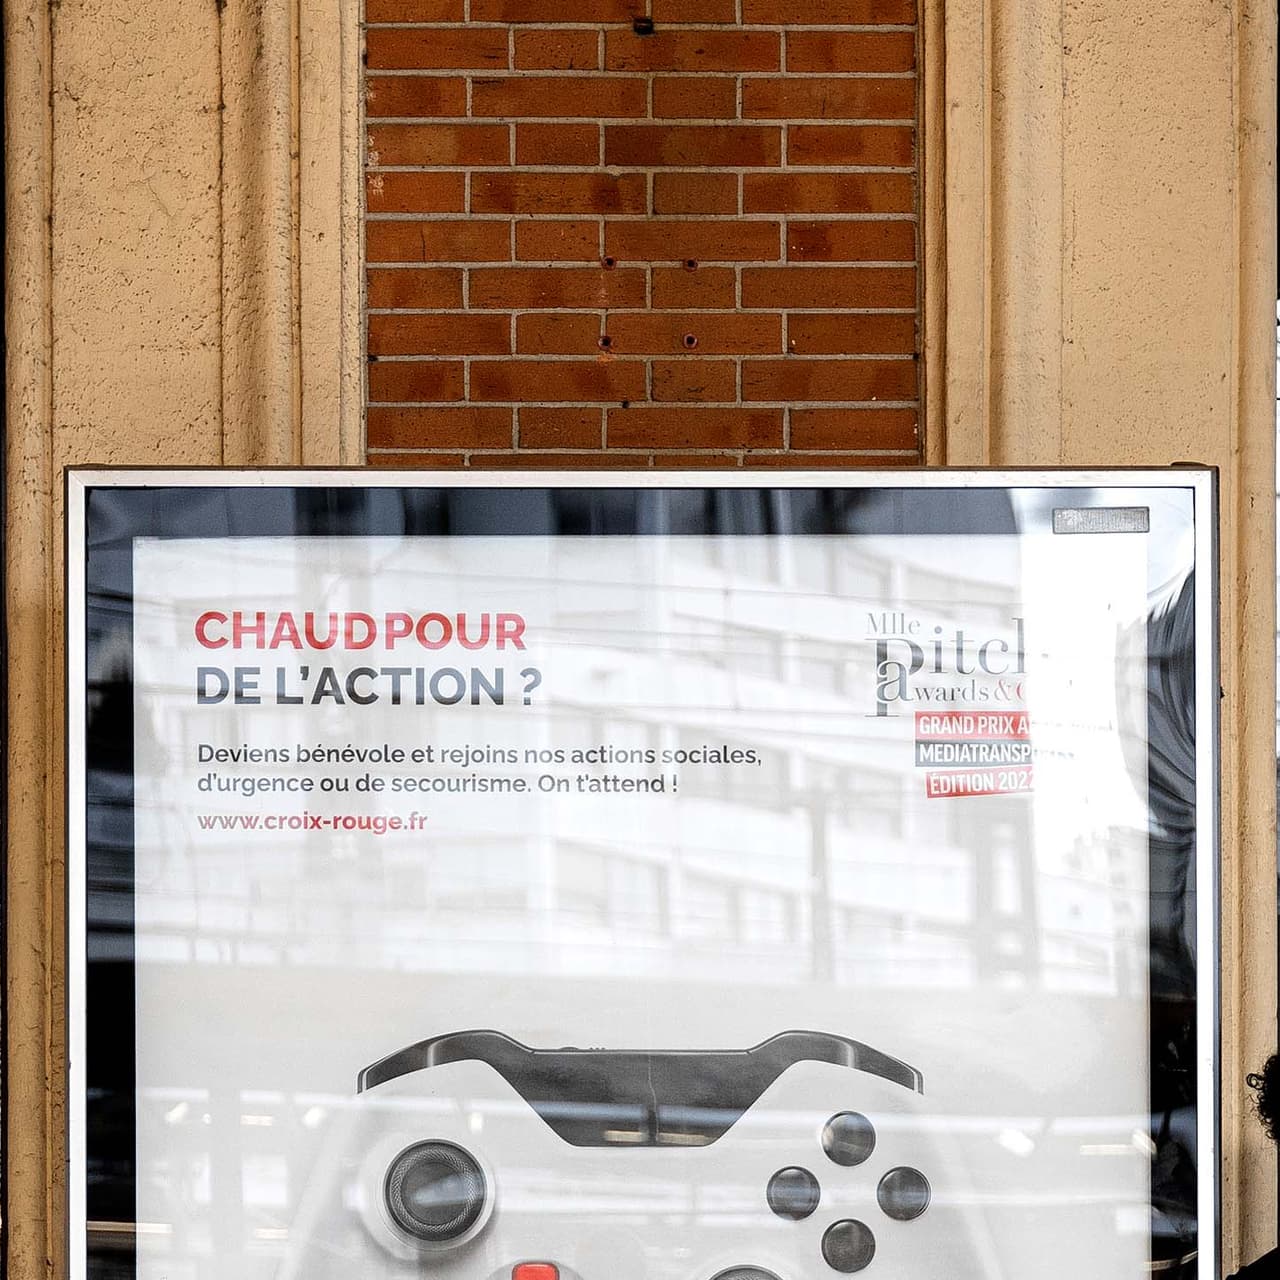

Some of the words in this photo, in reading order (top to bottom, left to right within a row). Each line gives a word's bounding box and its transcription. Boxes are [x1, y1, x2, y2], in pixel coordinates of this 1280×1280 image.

[194, 610, 377, 650] CHAUD
[384, 611, 528, 651] POUR
[196, 666, 262, 705] DE
[276, 665, 505, 706] L’ACTION
[519, 666, 543, 706] ?
[919, 715, 975, 735] GRAND
[977, 715, 1015, 735] PRIX
[198, 743, 290, 764] Deviens
[296, 743, 405, 764] bénévole
[410, 746, 435, 764] et
[440, 745, 519, 768] rejoins
[524, 749, 565, 764] nos
[571, 745, 656, 764] actions
[661, 745, 762, 767] sociales,
[197, 773, 314, 797] d’urgence
[320, 778, 349, 792] ou
[355, 773, 386, 792] de
[391, 774, 532, 793] secourisme.
[538, 774, 570, 793] On
[576, 774, 666, 793] t’attend
[197, 811, 428, 835] www.croix-rouge.fr
